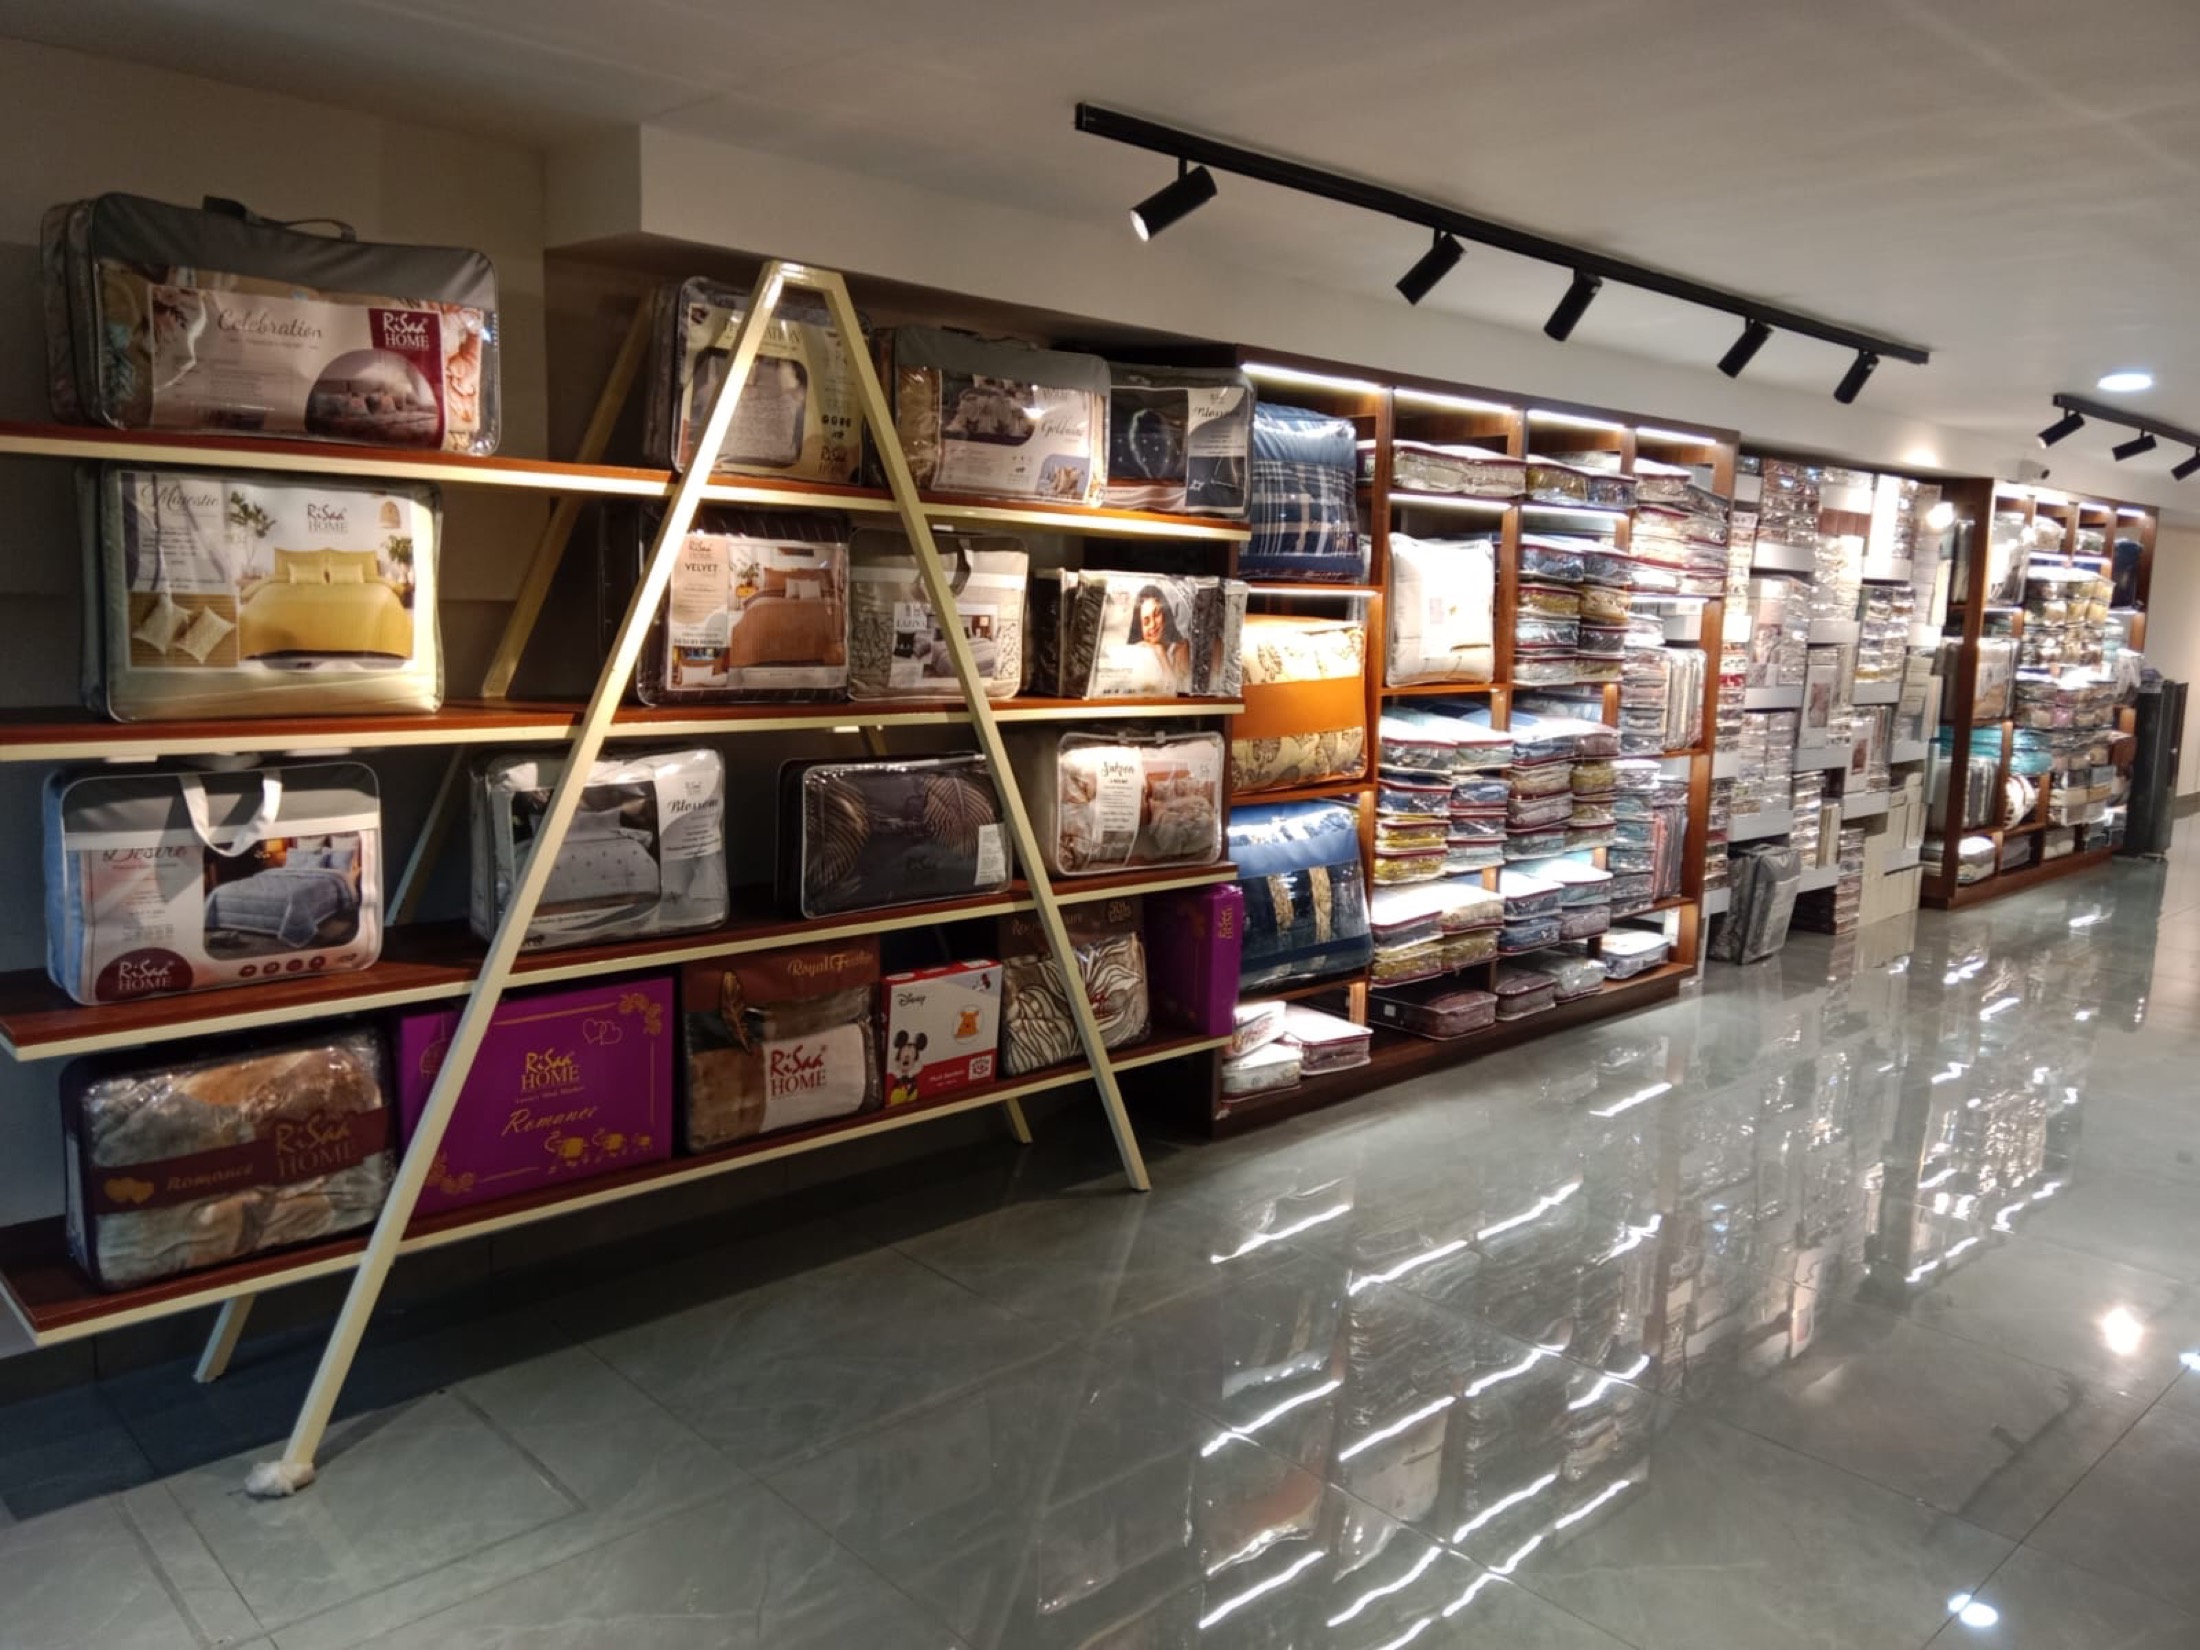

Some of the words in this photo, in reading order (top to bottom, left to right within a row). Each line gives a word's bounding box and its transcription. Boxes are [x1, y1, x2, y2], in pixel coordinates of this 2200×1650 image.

[218, 307, 324, 340] Celebration
[385, 334, 430, 349] HOME
[684, 562, 719, 573] VELVET
[521, 1065, 580, 1090] HOME
[770, 1069, 827, 1096] HOME
[166, 1162, 255, 1193] Romance
